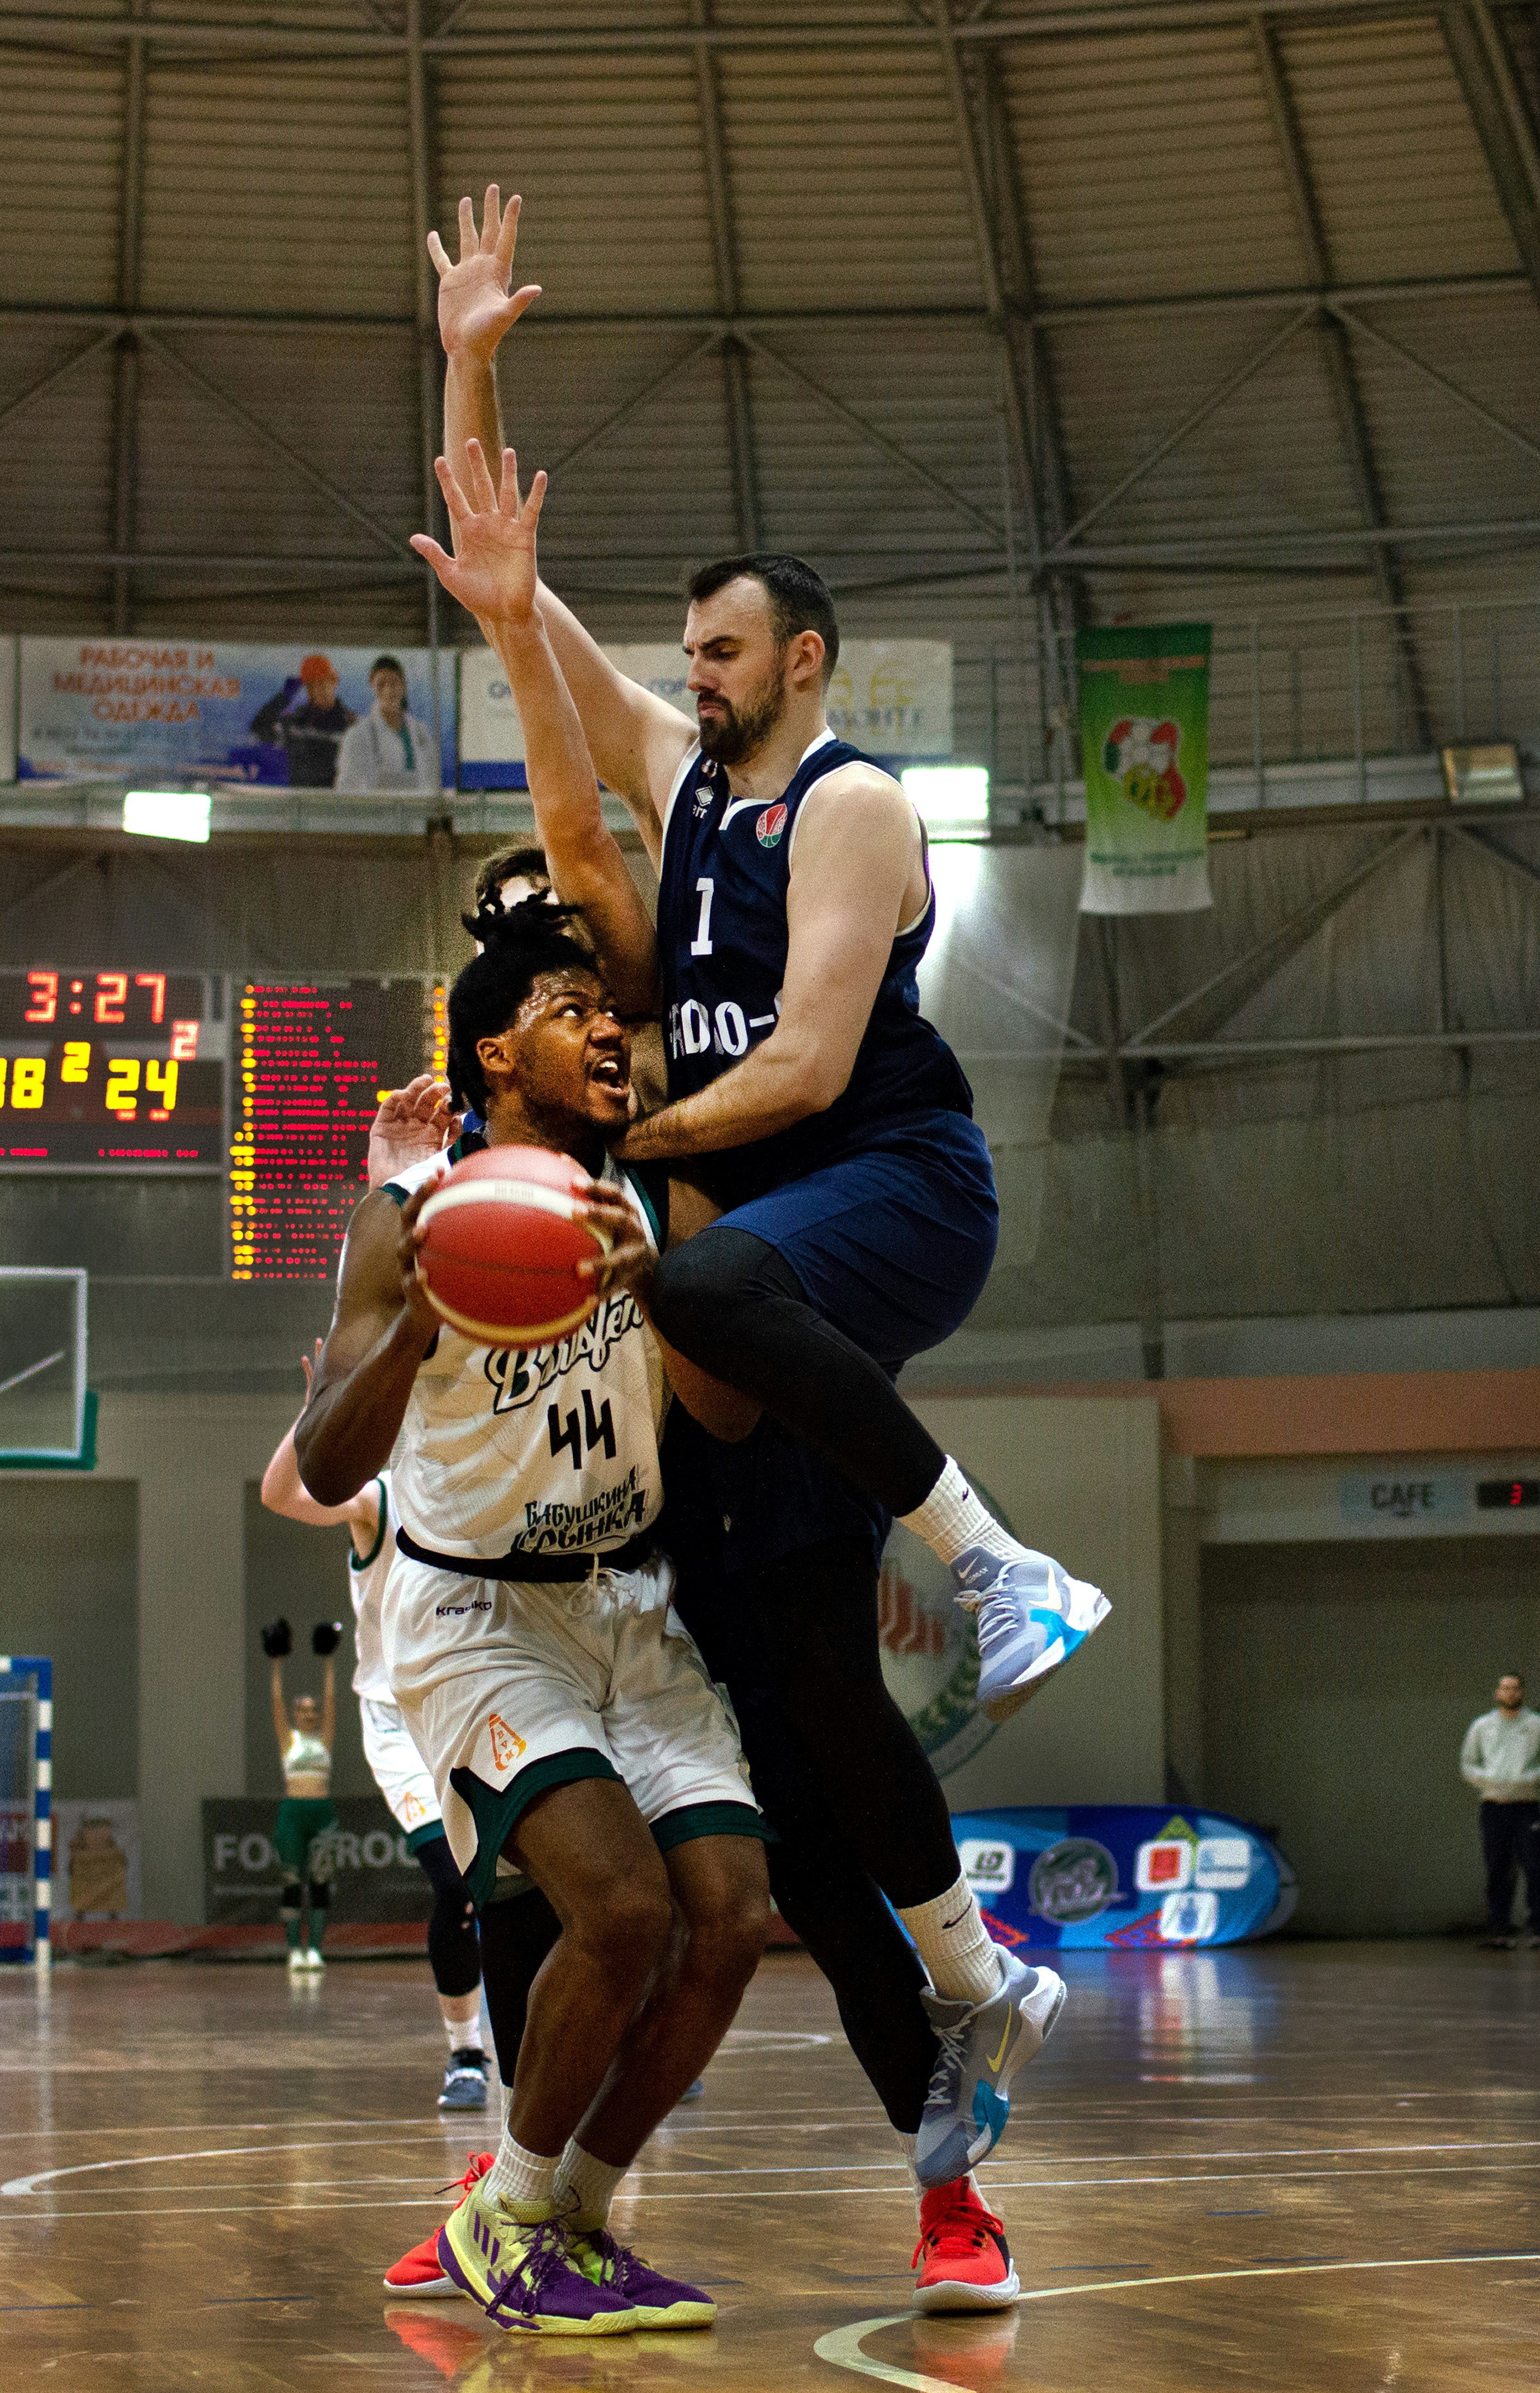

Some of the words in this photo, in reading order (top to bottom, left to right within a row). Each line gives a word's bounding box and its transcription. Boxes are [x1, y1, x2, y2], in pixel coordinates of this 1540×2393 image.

[80, 647, 189, 669] РАБОЧАЯ
[196, 650, 214, 669] И
[53, 672, 241, 698] МЕДИЦИНСКАЯ
[93, 700, 201, 724] ОДЕЖДА
[690, 877, 714, 956] 1
[25, 971, 166, 1024] 3:27
[170, 1020, 199, 1060] 2
[60, 1041, 91, 1082] 2
[0, 1058, 46, 1109] 8
[105, 1059, 179, 1110] 24
[547, 1389, 616, 1470] 44
[1372, 1482, 1433, 1510] CAFE
[1511, 1483, 1522, 1505] 3
